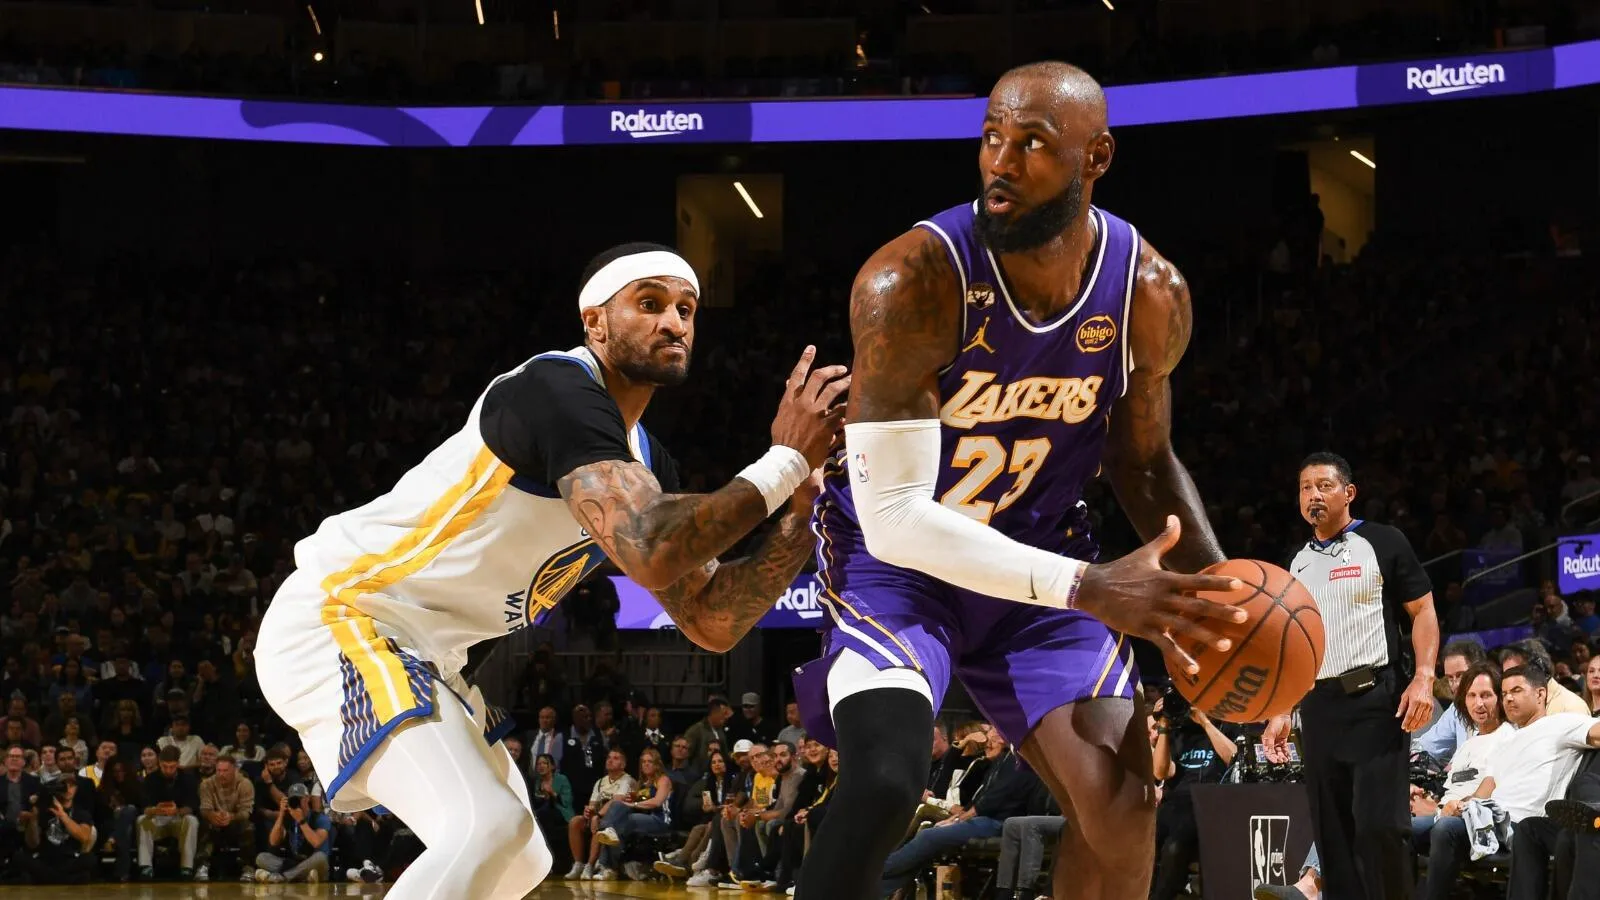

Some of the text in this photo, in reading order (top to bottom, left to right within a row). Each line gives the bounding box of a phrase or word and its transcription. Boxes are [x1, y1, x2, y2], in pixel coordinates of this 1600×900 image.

[1407, 62, 1505, 90] Rakuten
[611, 109, 703, 131] Rakuten
[1080, 325, 1113, 341] bibigo
[940, 371, 1103, 429] LAKERS
[941, 436, 1051, 525] 23
[1330, 568, 1360, 579] Emirates
